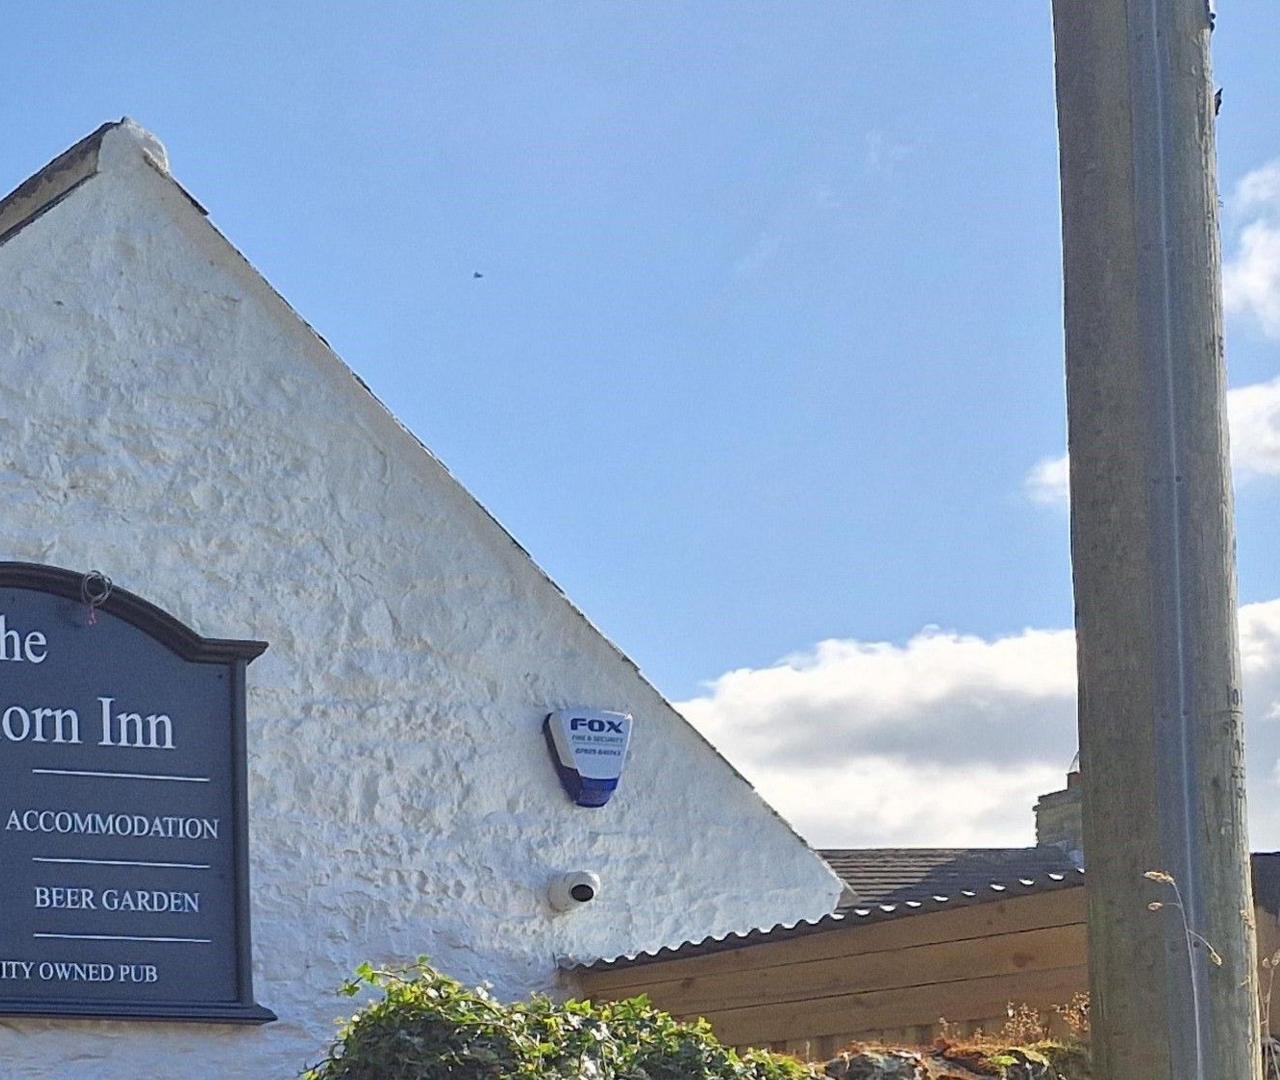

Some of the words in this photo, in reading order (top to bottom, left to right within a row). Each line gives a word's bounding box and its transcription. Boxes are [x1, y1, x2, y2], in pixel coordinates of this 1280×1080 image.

[97, 697, 177, 749] Inn
[570, 718, 623, 733] FOX
[5, 809, 219, 839] ACCOMMODATION
[34, 886, 97, 910] BEER
[101, 888, 200, 913] GARDEN
[39, 961, 114, 982] OWNED
[119, 963, 158, 983] PUB
